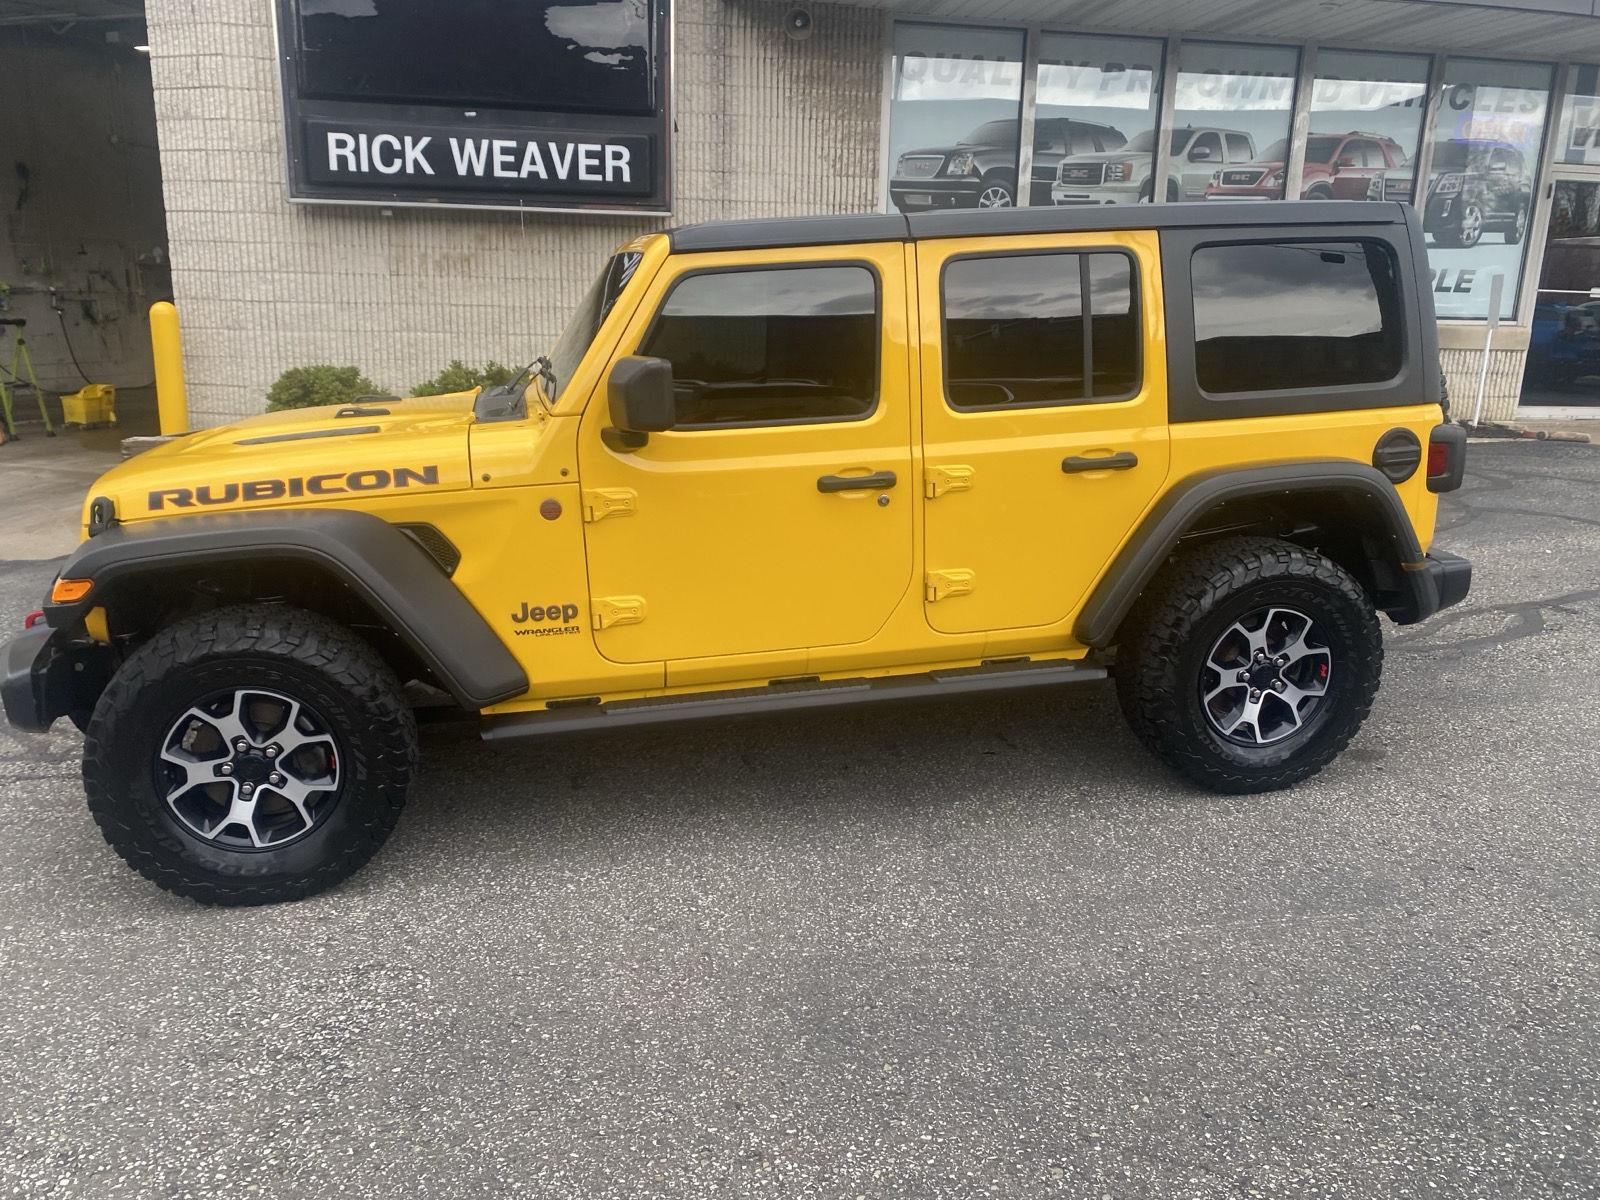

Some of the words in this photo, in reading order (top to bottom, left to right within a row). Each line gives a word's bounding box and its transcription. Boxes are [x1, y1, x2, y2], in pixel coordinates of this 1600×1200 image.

[901, 51, 1091, 89] QUALTY
[1099, 62, 1342, 103] PR-OWND
[1358, 77, 1540, 113] VEHCLES
[327, 131, 435, 175] RICK
[449, 137, 631, 183] WEAVER
[148, 465, 439, 511] RUBICON
[511, 602, 578, 624] Jeep
[514, 625, 580, 636] WRANGLER
